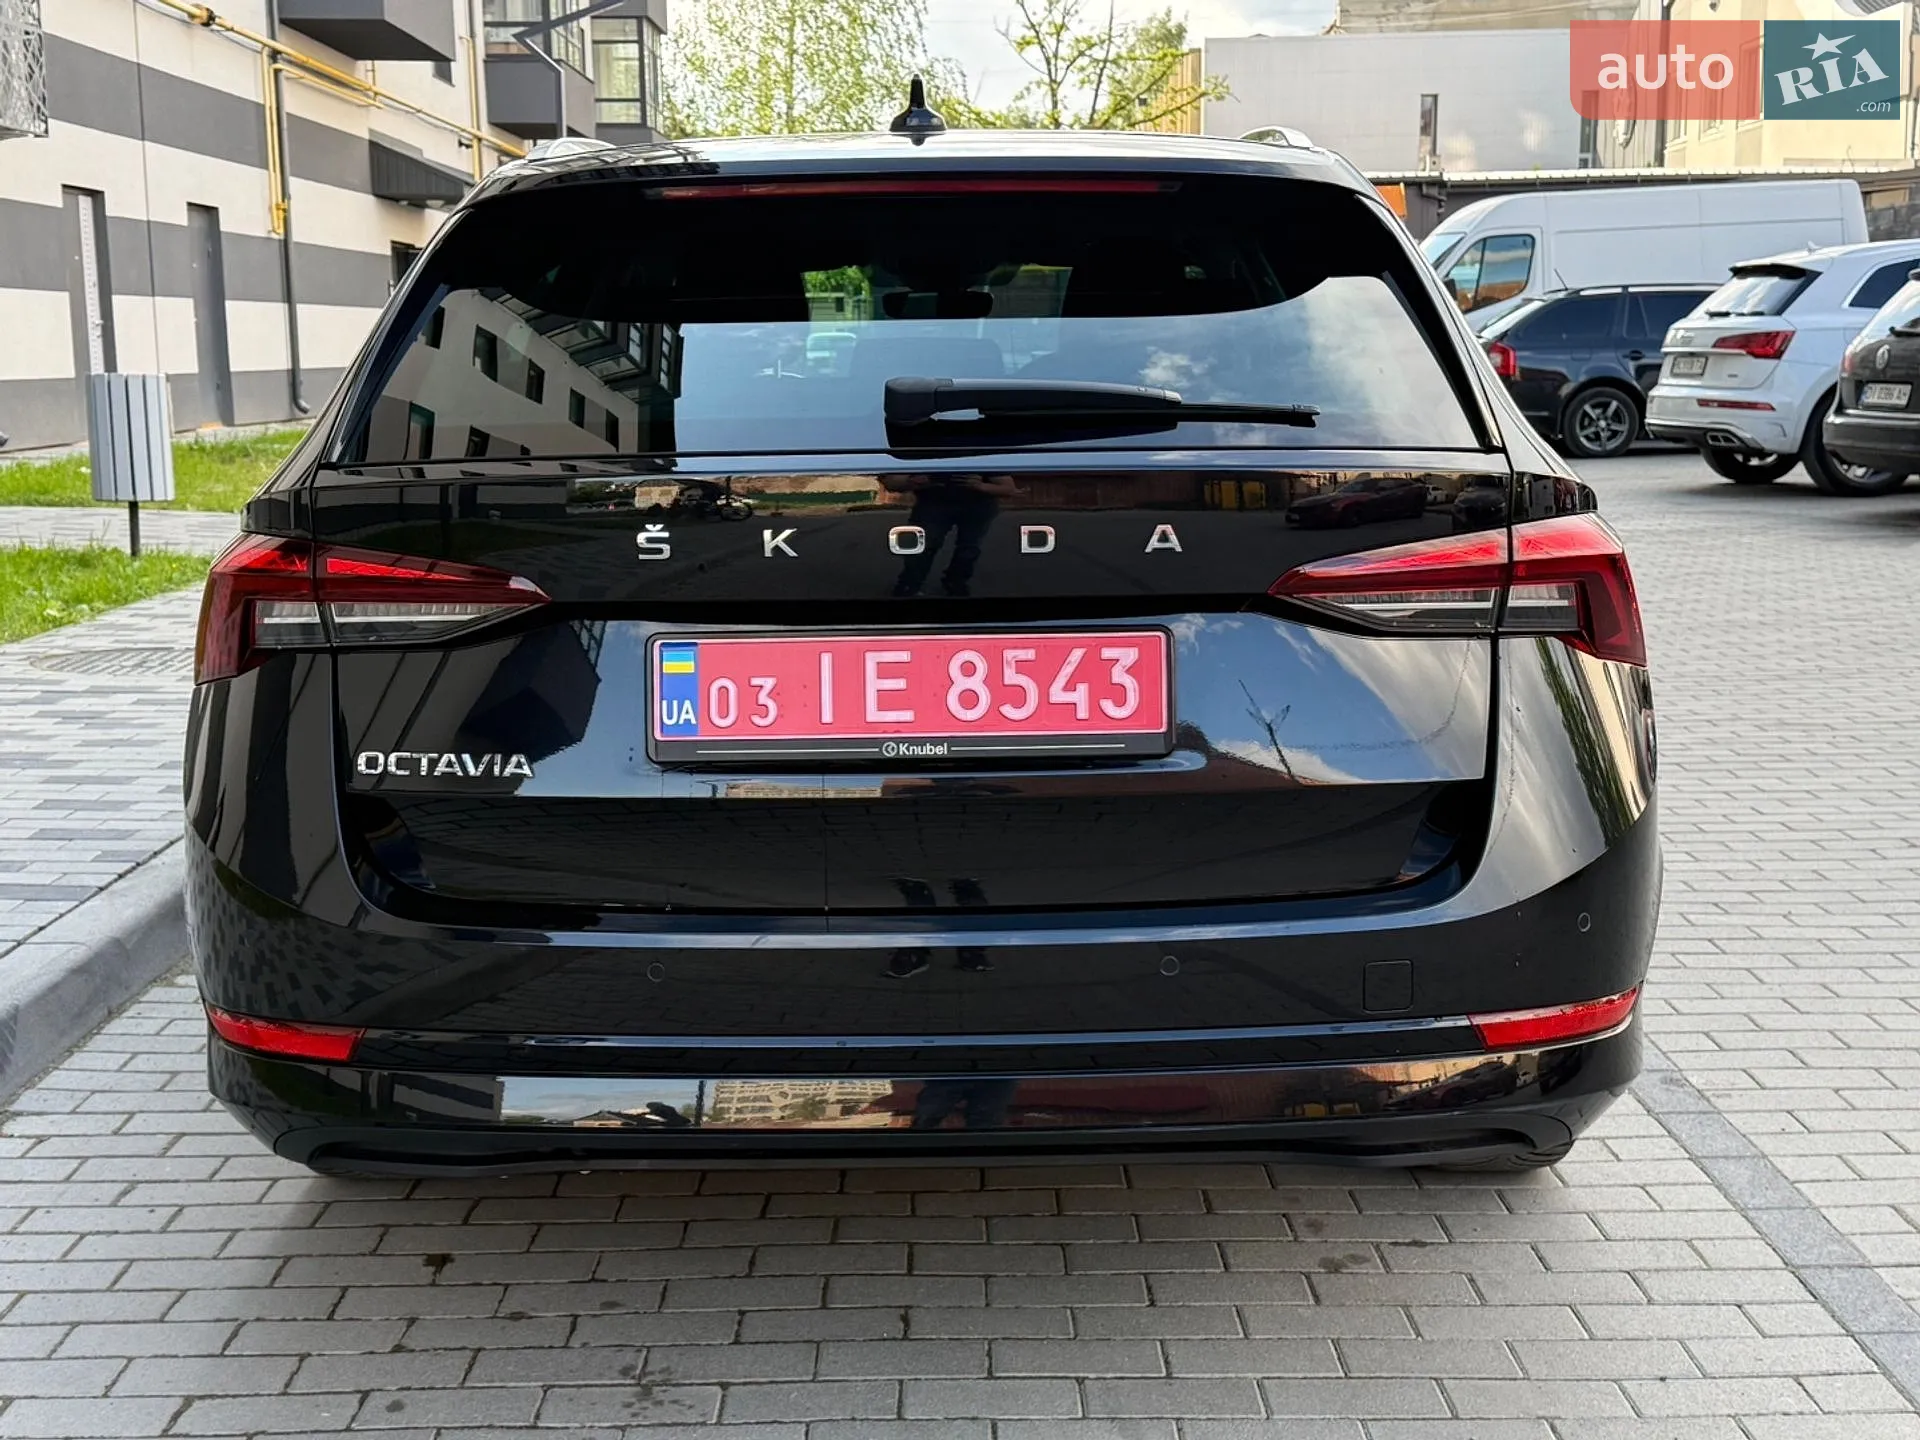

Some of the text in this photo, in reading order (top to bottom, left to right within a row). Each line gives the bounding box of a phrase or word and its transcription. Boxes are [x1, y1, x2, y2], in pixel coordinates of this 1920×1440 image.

[661, 646, 1140, 729] UA 03 IE 8543
[899, 742, 948, 755] Knubel
[356, 751, 534, 777] OCTAVIA
